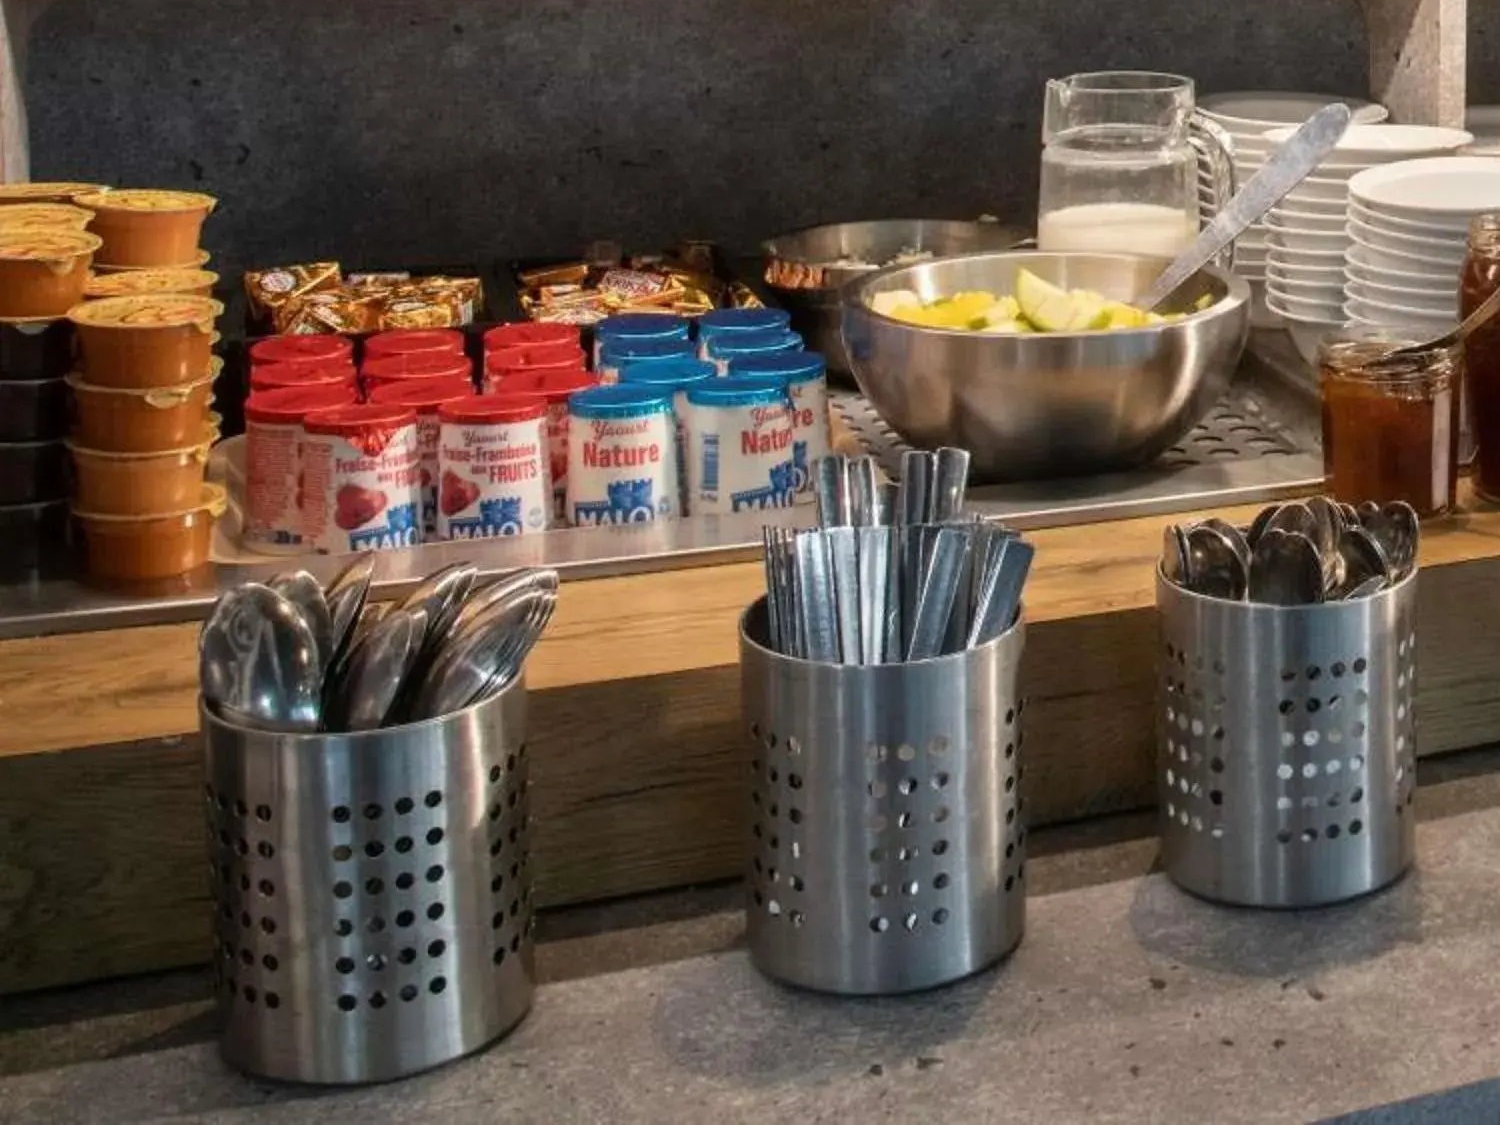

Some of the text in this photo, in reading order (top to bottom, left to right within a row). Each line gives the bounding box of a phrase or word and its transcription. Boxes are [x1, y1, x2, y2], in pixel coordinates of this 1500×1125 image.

[583, 442, 659, 467] Nature
[489, 460, 537, 484] FRUITS
[579, 506, 652, 527] MALO
[450, 522, 520, 539] MALO
